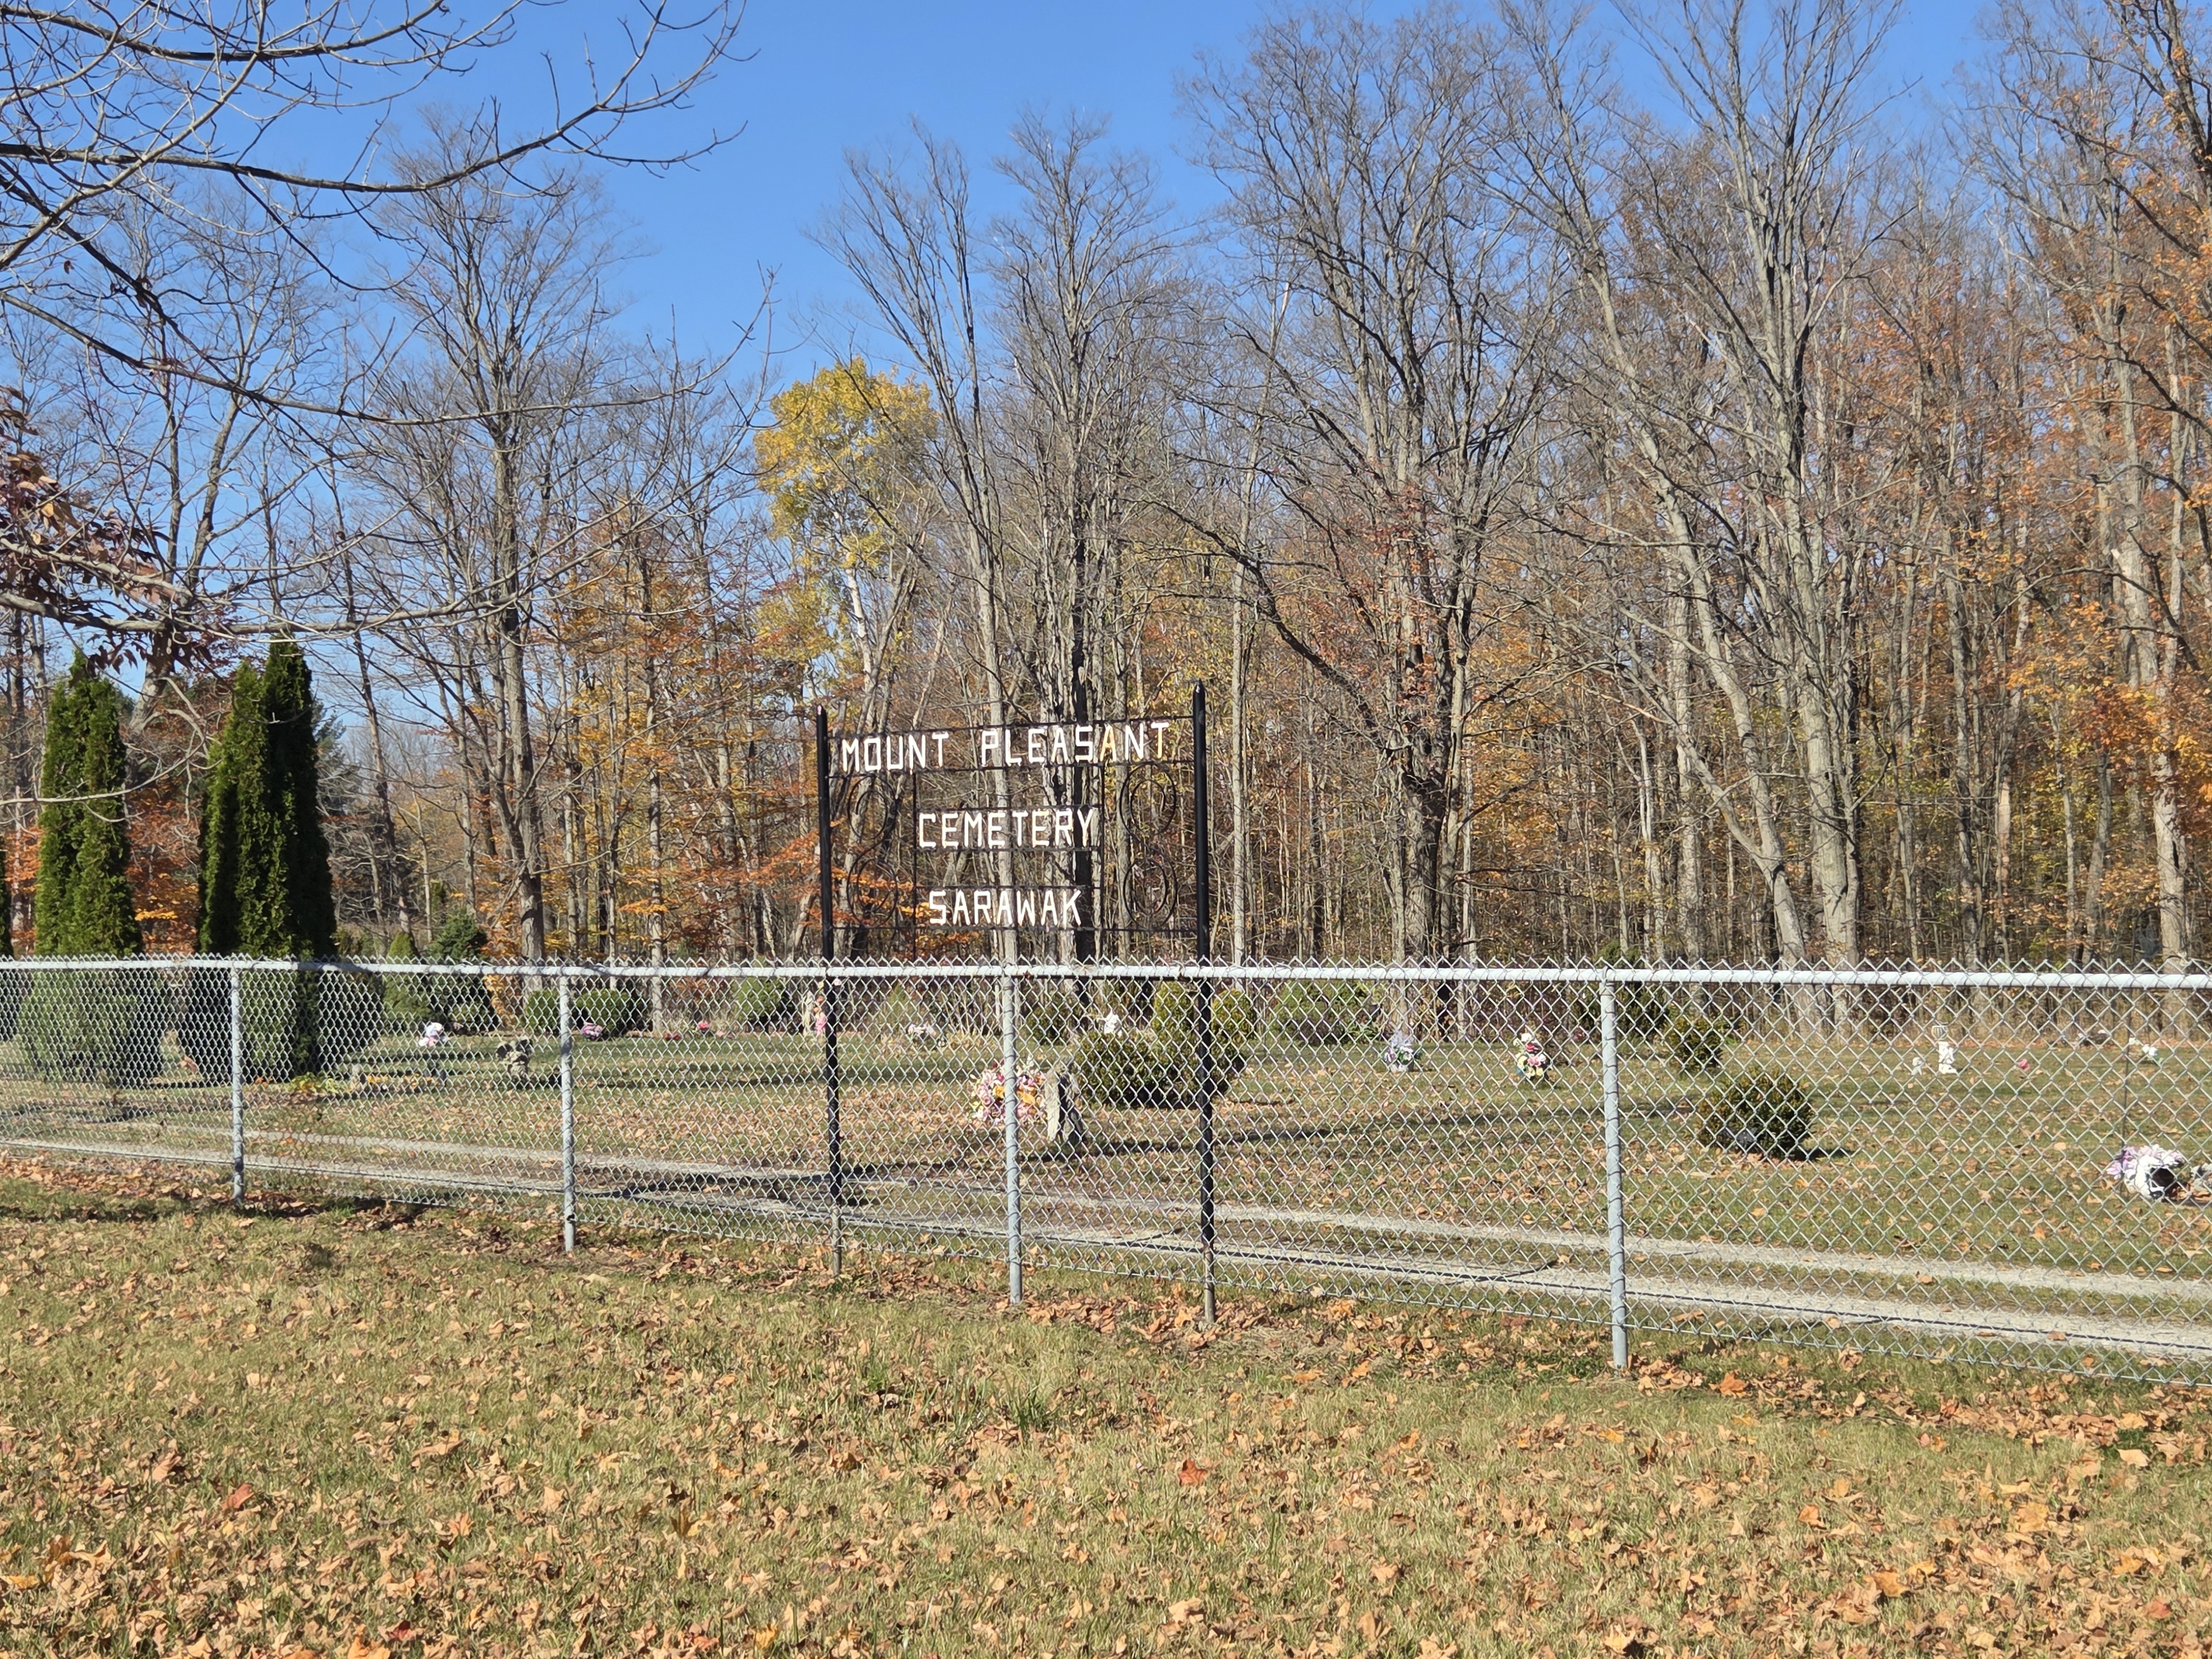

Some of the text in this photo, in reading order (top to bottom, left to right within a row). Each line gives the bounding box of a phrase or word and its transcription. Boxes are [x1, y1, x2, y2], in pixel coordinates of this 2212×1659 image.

[841, 722, 1170, 773] MOUNT PLEASANT
[919, 807, 1095, 848] CEMETERY
[929, 889, 1082, 926] SARAWAK
